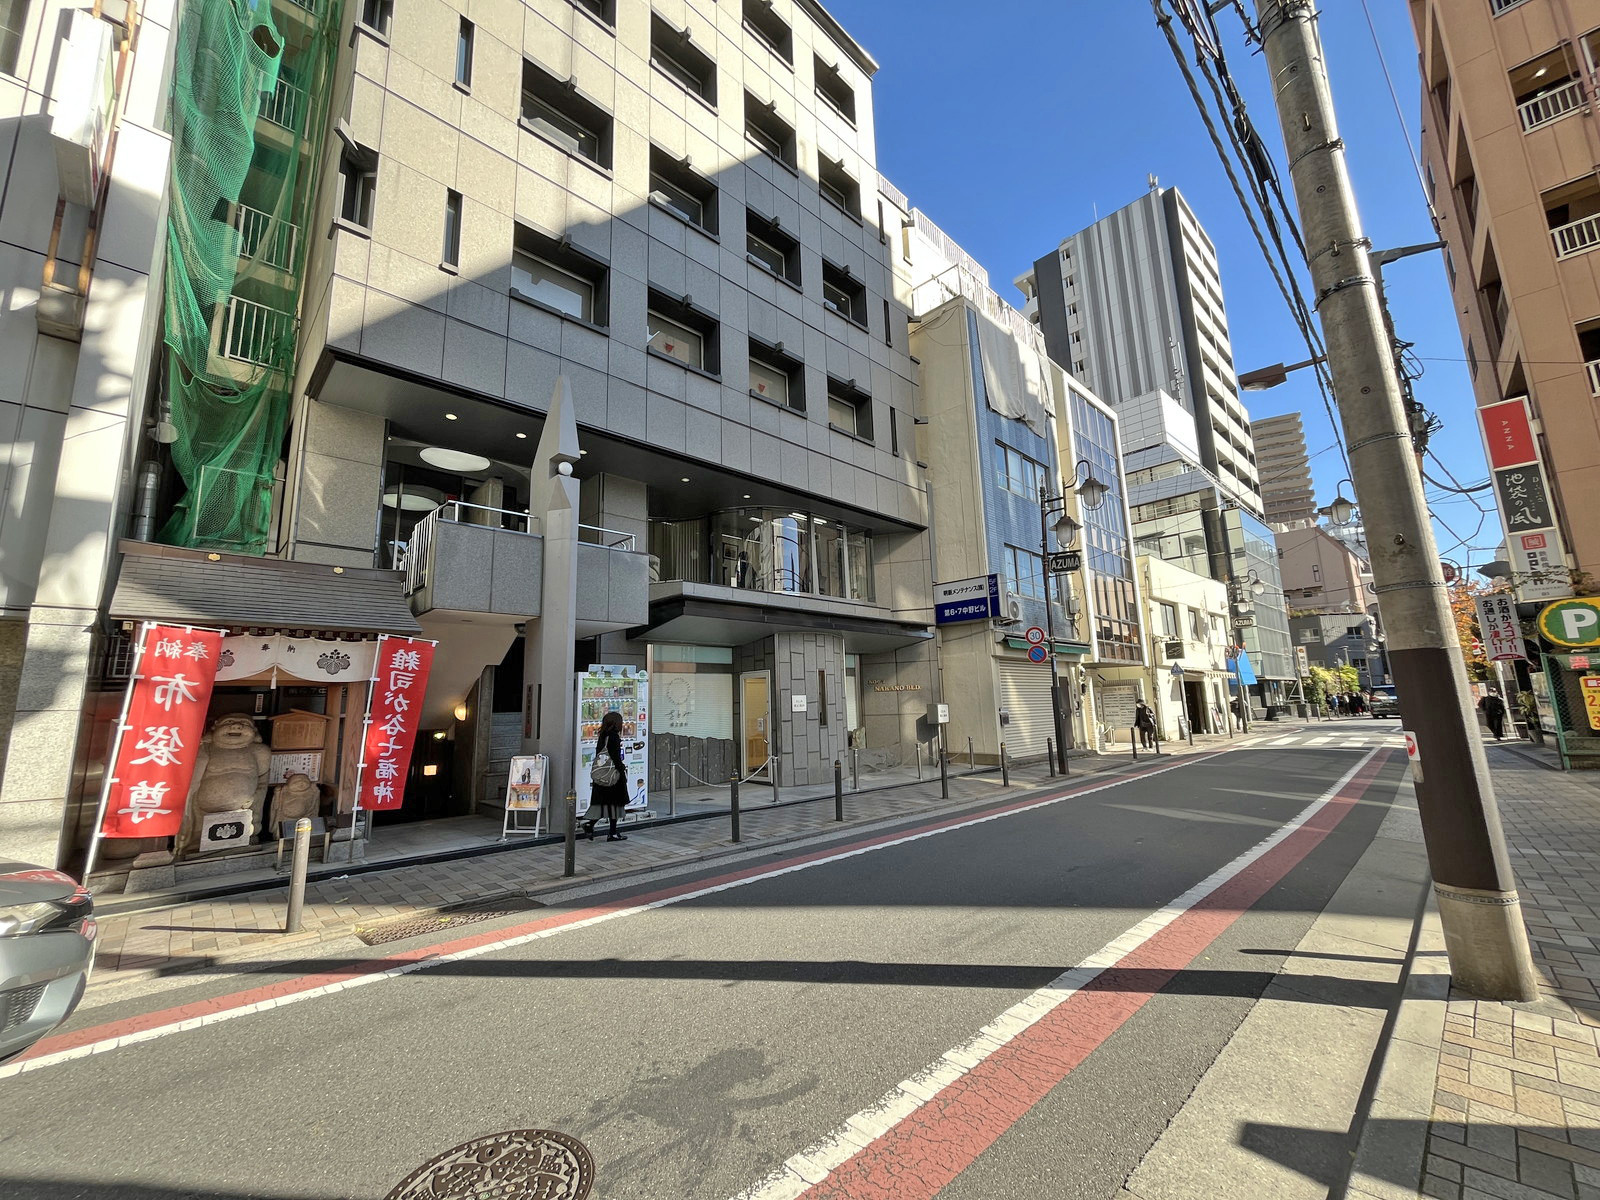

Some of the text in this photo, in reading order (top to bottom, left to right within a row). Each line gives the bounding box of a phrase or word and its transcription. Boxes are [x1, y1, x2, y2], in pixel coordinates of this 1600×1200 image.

[1501, 420, 1515, 450] ANNA
[1505, 473, 1542, 524] 池袋の風
[1051, 557, 1080, 569] AZUMA
[1029, 632, 1040, 640] 30
[1561, 608, 1597, 639] P
